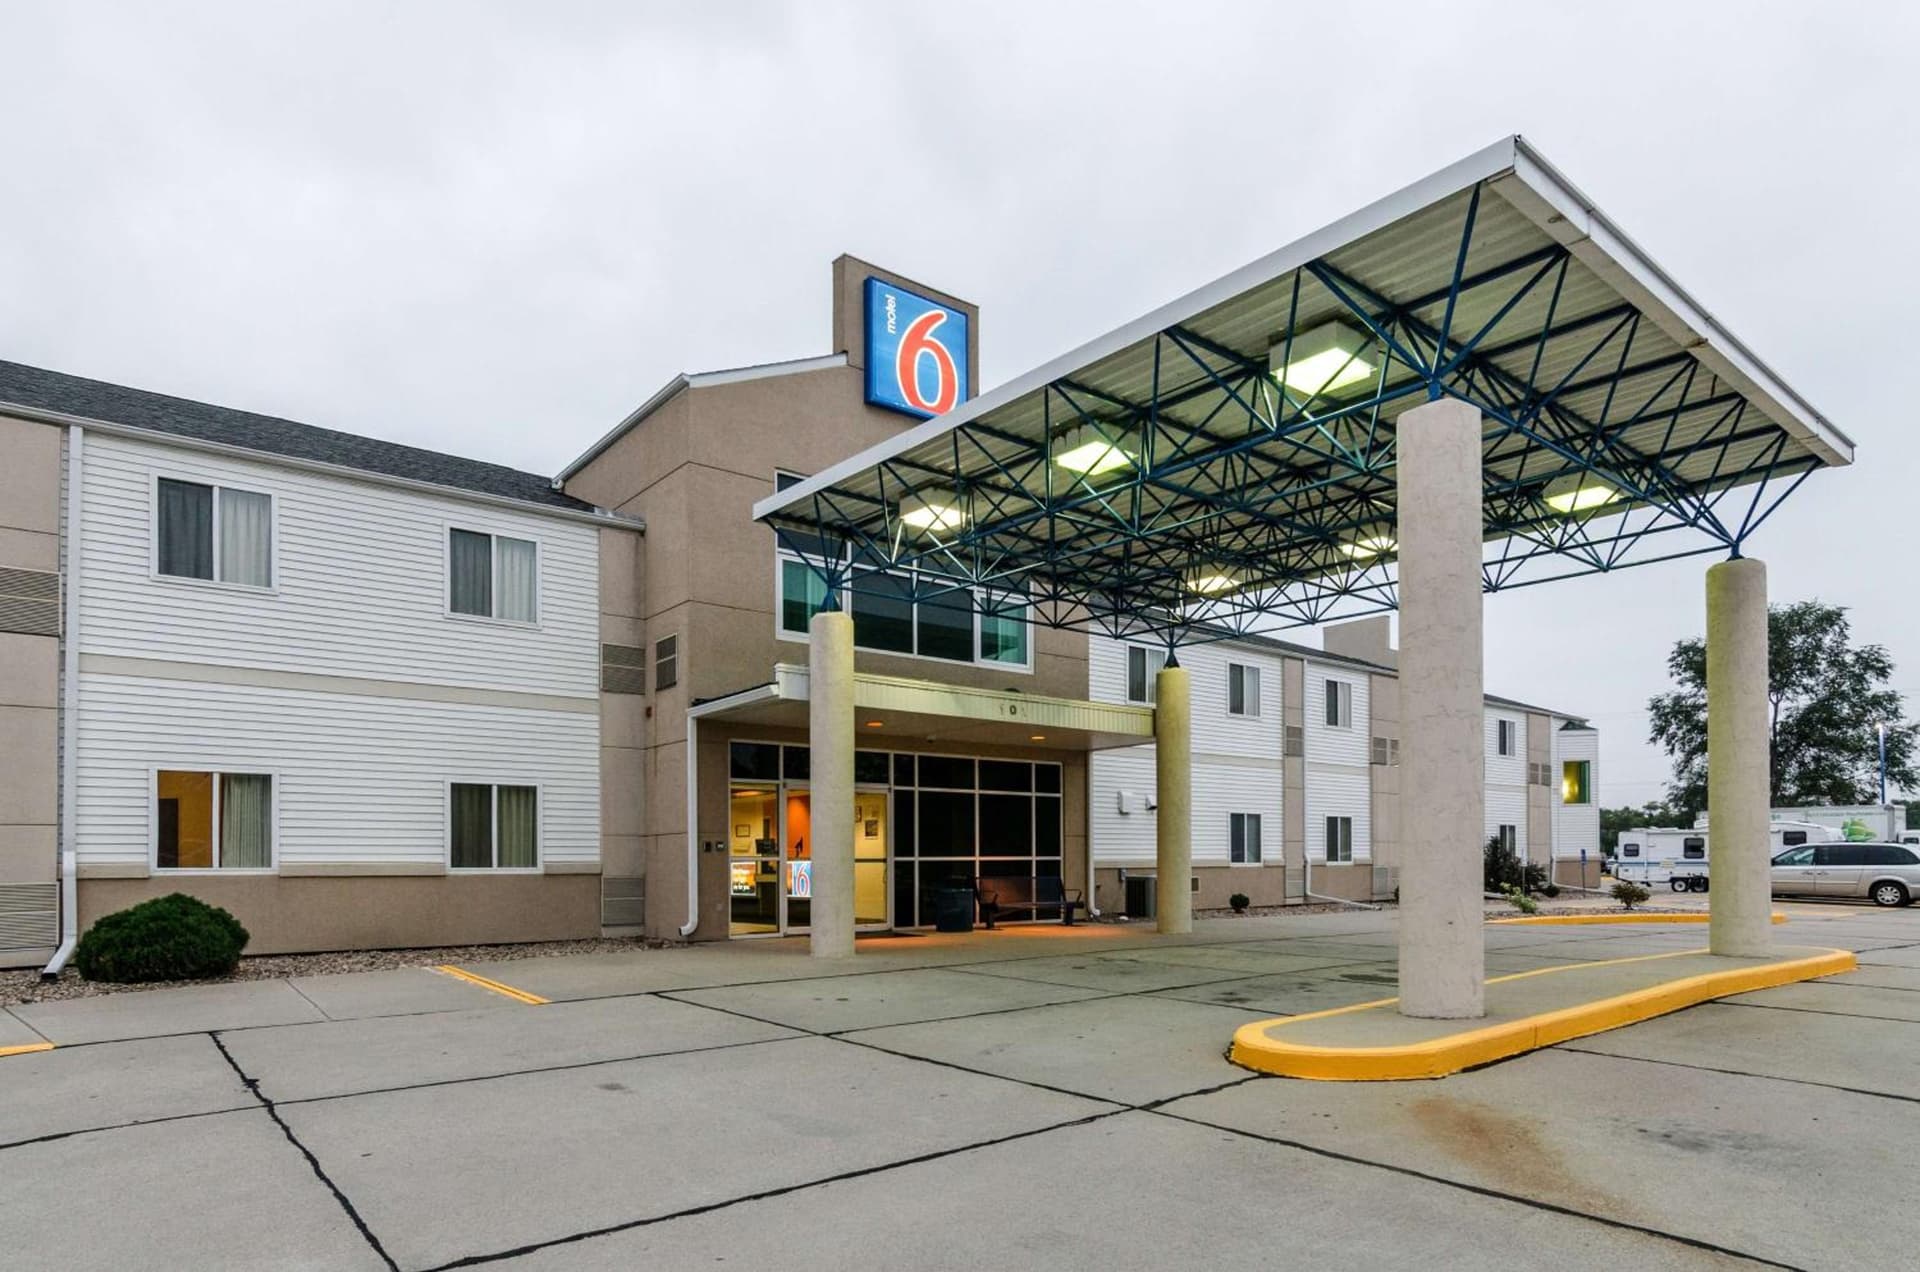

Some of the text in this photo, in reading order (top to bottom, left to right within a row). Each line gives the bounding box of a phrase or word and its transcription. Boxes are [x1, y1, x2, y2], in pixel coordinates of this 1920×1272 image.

[885, 294, 958, 416] motel 6
[795, 863, 810, 896] 6
